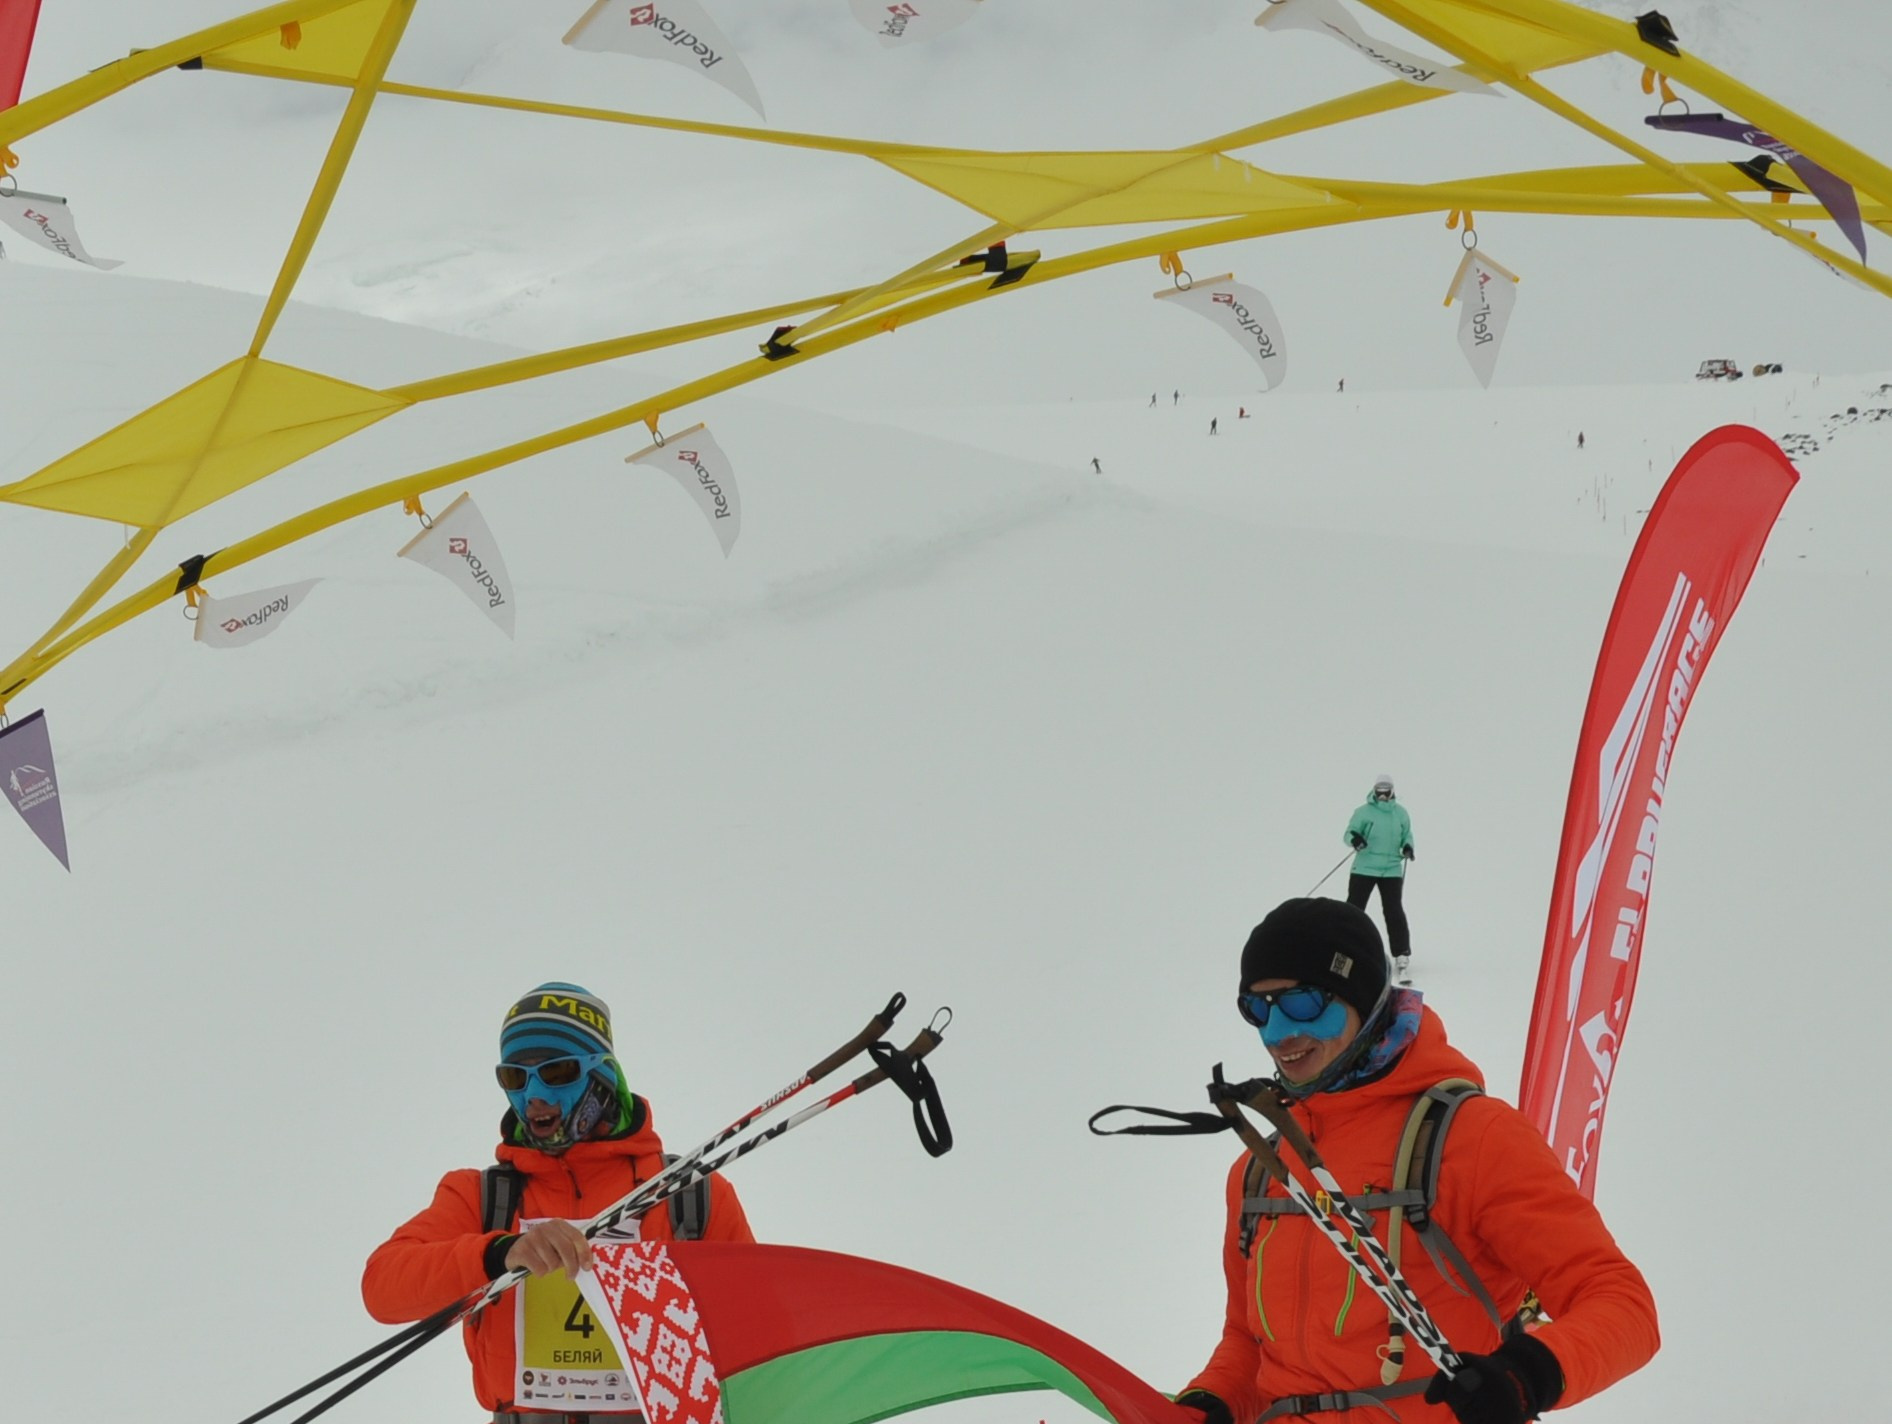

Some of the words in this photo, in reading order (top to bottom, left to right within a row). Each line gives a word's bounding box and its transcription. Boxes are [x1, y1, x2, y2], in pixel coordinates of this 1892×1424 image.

[650, 13, 724, 69] RedFox
[1232, 301, 1277, 359] RedFox
[693, 460, 731, 520] RedFox
[464, 549, 506, 609] RedFox
[241, 595, 289, 628] RedFox
[760, 1075, 814, 1111] ADSHUS
[564, 1292, 595, 1339] 4
[553, 1348, 602, 1364] БЕЛЯЙ
